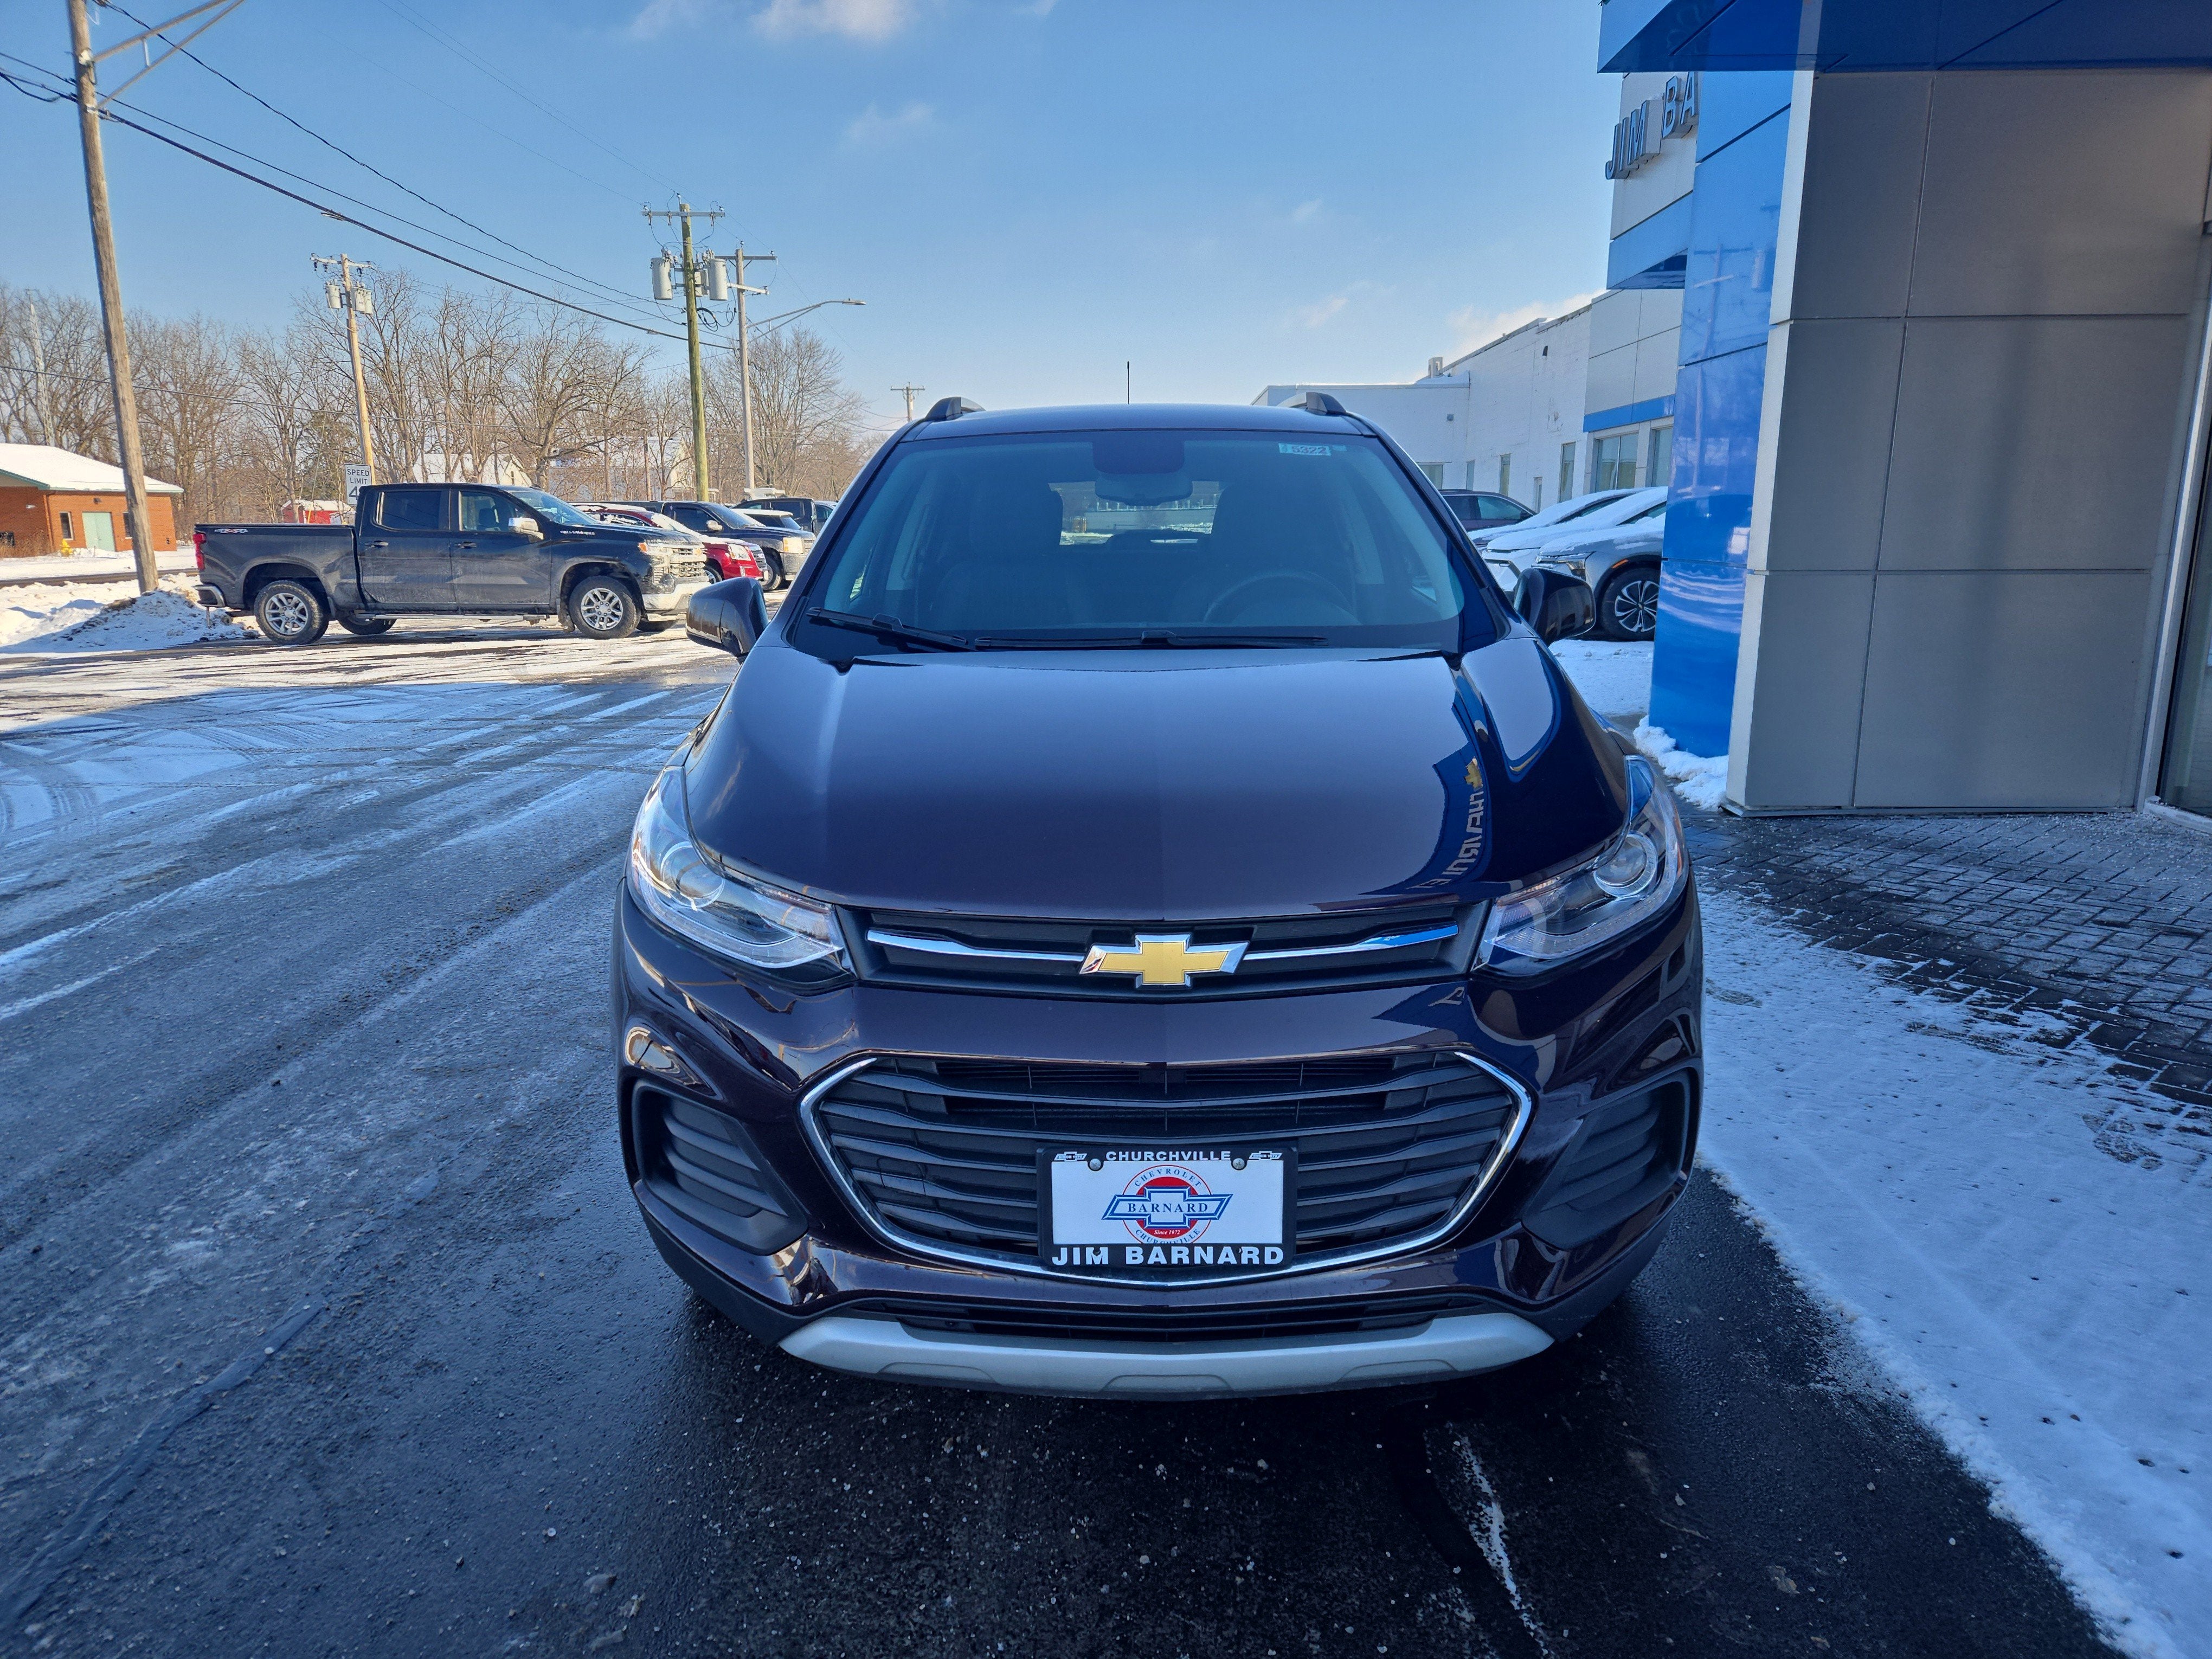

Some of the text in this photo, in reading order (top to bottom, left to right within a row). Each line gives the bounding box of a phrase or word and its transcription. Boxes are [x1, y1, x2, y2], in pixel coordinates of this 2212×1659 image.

[1605, 100, 1649, 180] JIM
[1105, 1151, 1231, 1161] CHURCHVILLE
[1134, 1168, 1201, 1187] CHEVROLET
[1128, 1203, 1208, 1212] BARNARD
[1052, 1246, 1284, 1265] JIM BARNARD
